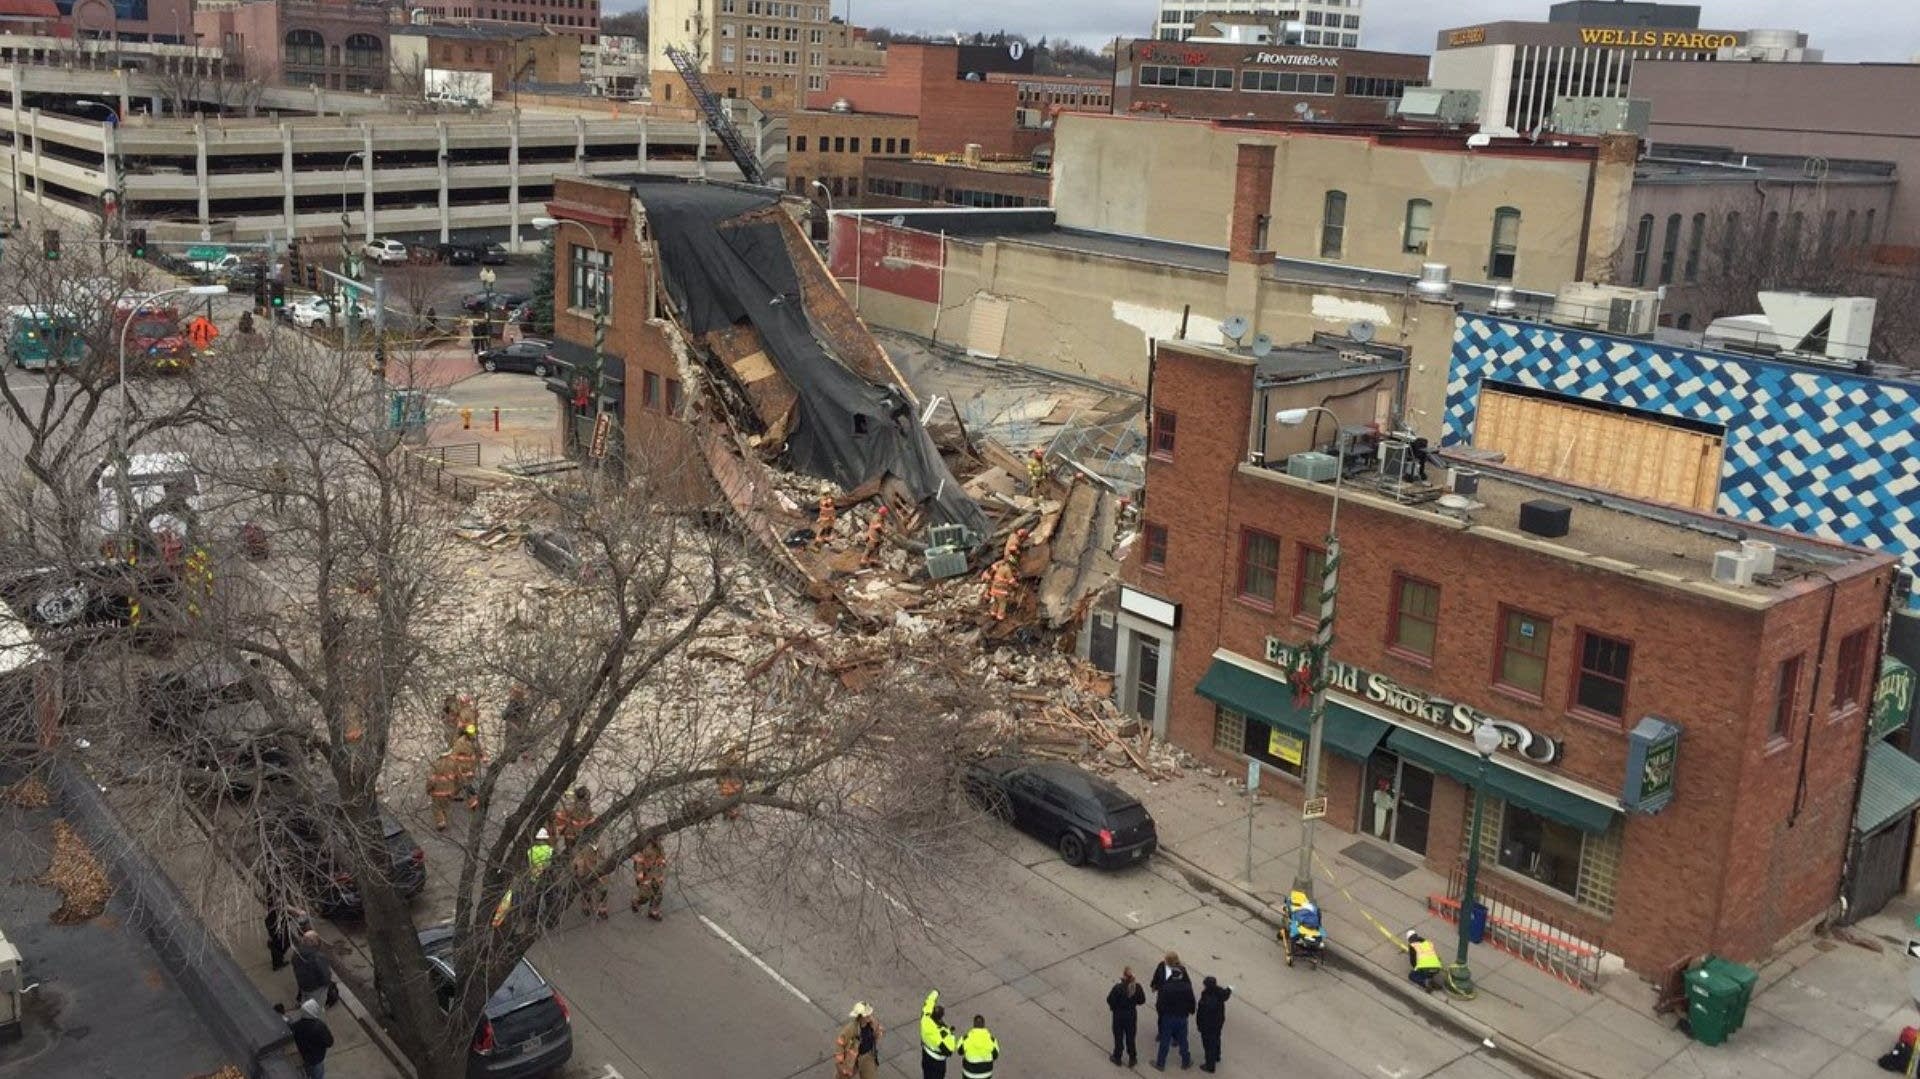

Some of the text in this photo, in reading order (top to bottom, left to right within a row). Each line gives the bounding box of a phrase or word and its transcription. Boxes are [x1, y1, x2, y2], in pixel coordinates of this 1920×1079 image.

[1581, 28, 1737, 49] WELLS FARGO
[1451, 703, 1517, 750] SP
